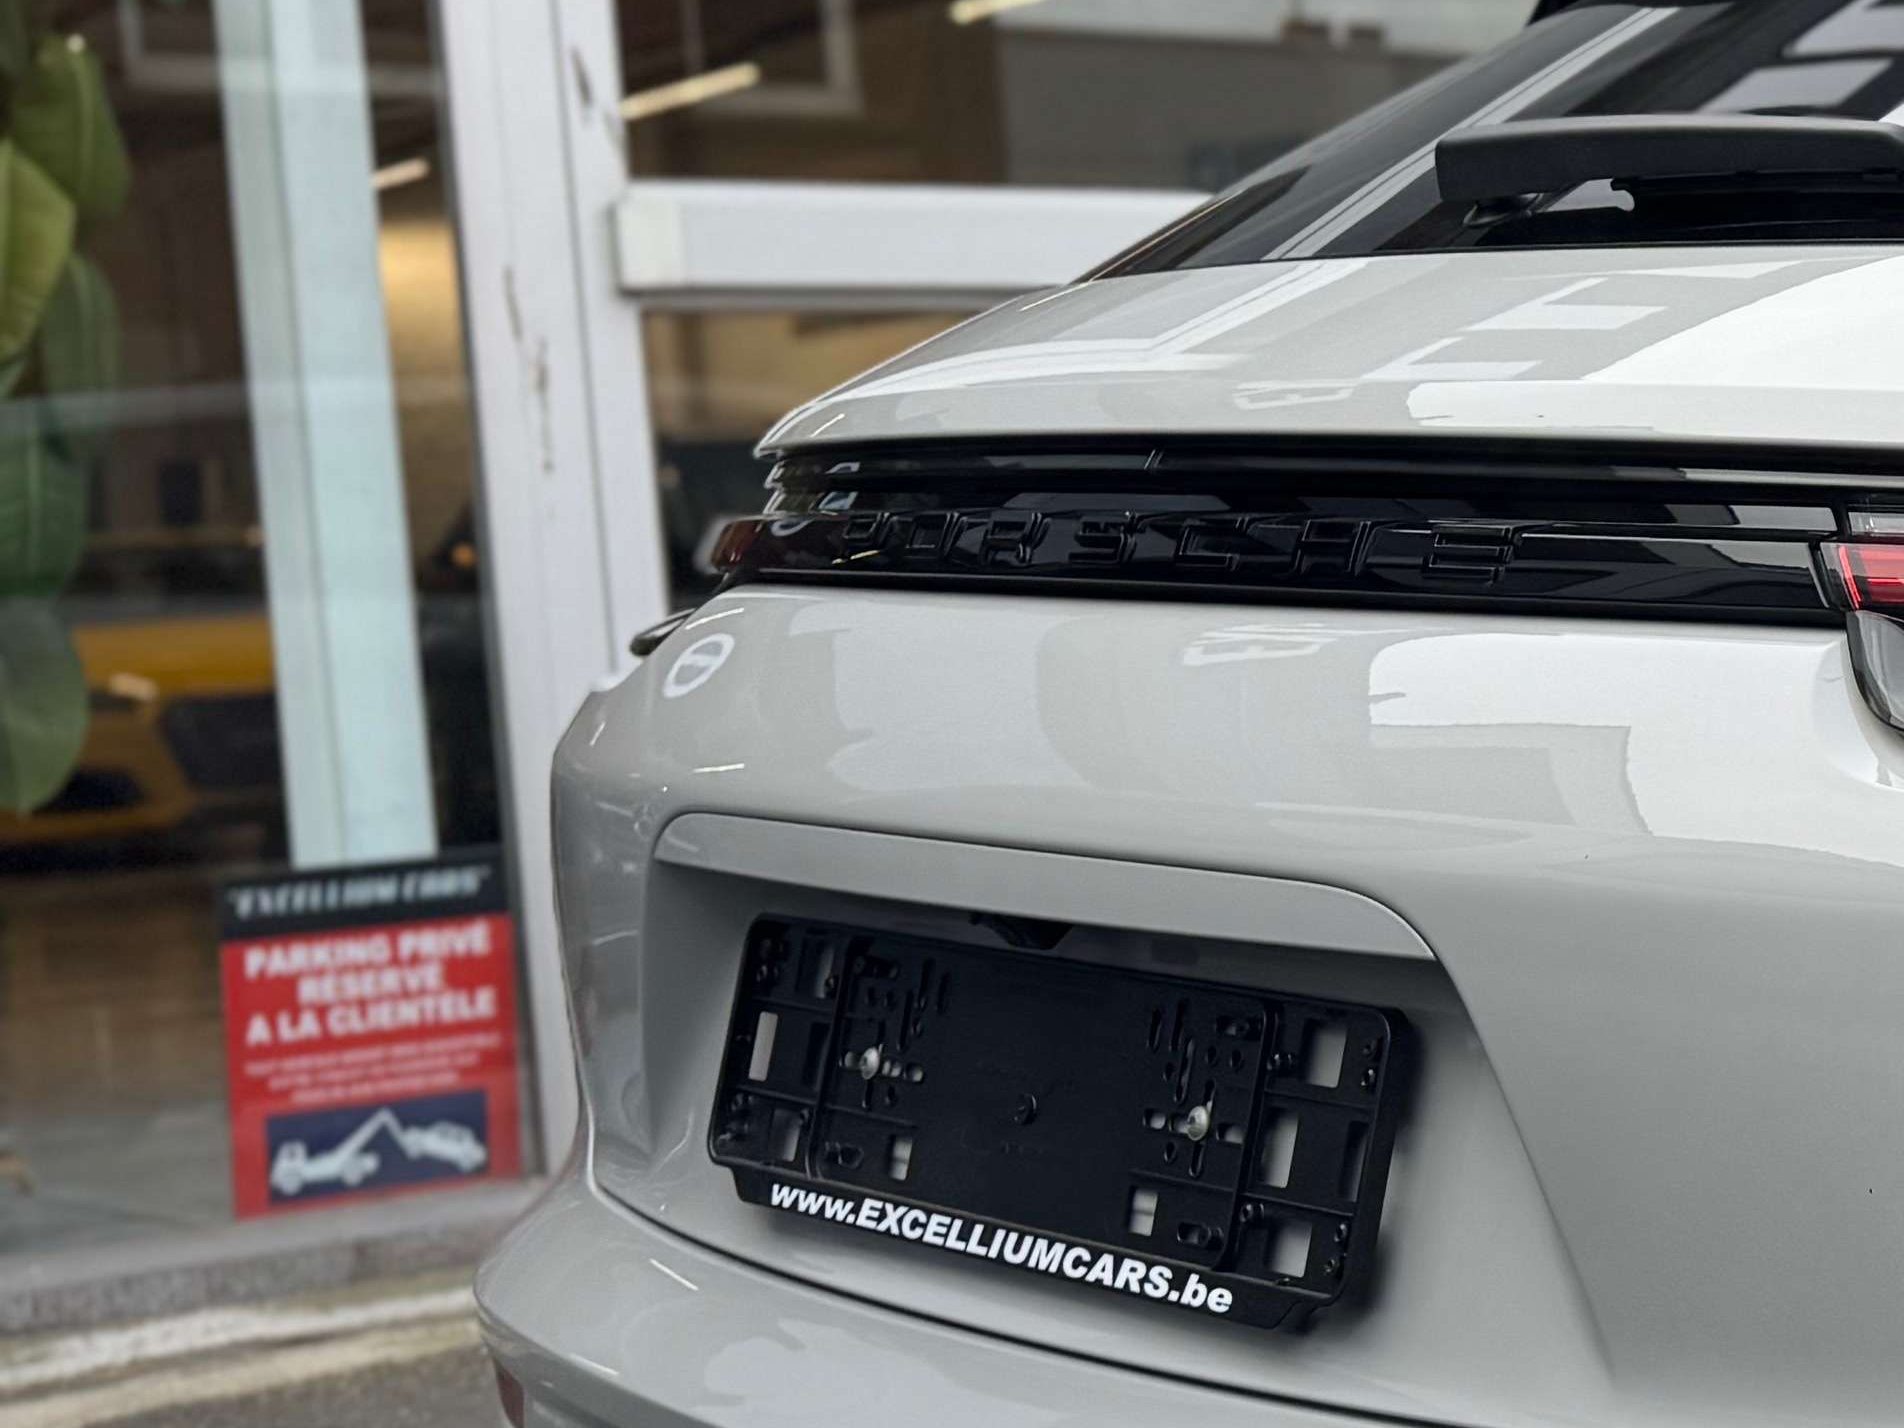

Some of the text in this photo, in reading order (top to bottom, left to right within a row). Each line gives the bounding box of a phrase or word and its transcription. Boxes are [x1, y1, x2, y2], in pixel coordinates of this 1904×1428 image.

[838, 510, 1516, 585] PORSCHE
[244, 933, 391, 979] PARKING
[276, 1007, 322, 1043] LA
[770, 1183, 1233, 1314] www.EXCELLIUMCARS.be
